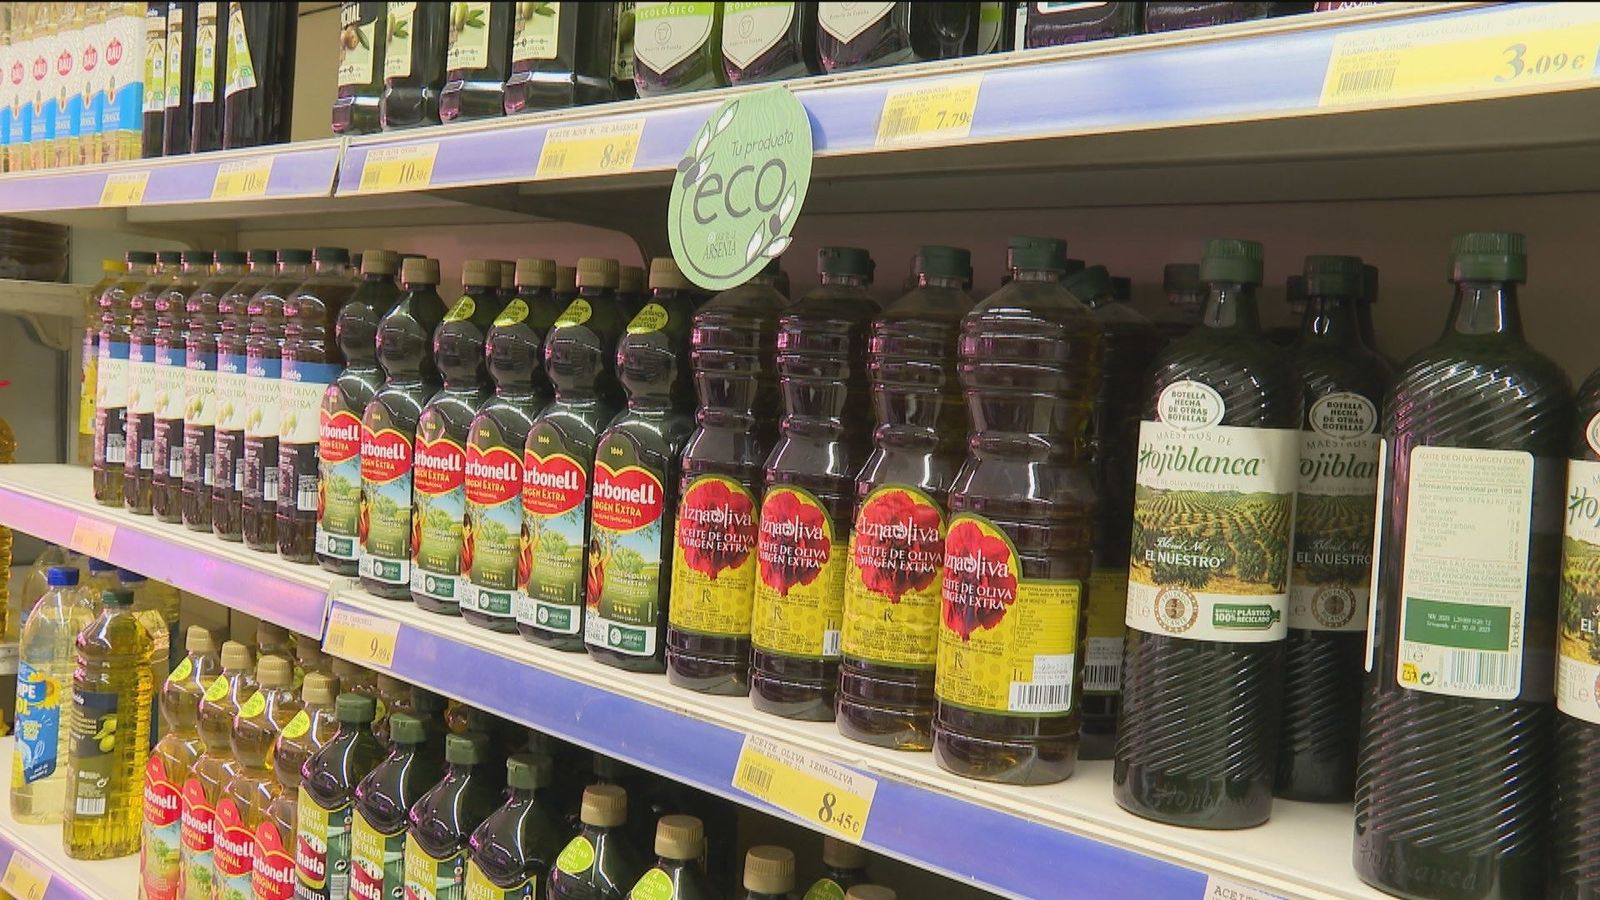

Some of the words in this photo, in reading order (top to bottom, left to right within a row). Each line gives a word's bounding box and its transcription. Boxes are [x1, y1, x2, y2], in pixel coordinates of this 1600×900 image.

[731, 141, 742, 157] Tu
[744, 129, 794, 159] producto
[693, 158, 787, 225] eco
[1171, 391, 1206, 400] BOTELLA
[1174, 399, 1201, 407] HECHA
[1168, 405, 1178, 413] DE
[1180, 407, 1208, 415] OTRAS
[1326, 402, 1363, 410] BOTELLA
[1167, 414, 1207, 423] BOTELLAS
[1323, 423, 1364, 431] BOTELLAS
[1337, 416, 1364, 424] OTRAS
[320, 422, 360, 441] arbonell
[1156, 431, 1212, 442] MAESTROS
[1217, 435, 1232, 446] DE
[361, 440, 406, 460] arbonell
[415, 451, 462, 471] arbonell
[1139, 442, 1261, 477] Hojiblanca
[1452, 454, 1473, 462] OLIVA
[1475, 455, 1503, 463] VIRGEN
[1504, 457, 1526, 465] EXTRA
[465, 457, 518, 481] arbonell
[483, 480, 506, 493] EXTRA
[523, 467, 579, 491] arbonell
[523, 486, 541, 498] IRGEN
[542, 487, 567, 502] EXTRA
[593, 478, 656, 505] arbonell
[592, 500, 614, 513] IRGEN
[615, 503, 642, 518] EXTRA
[682, 536, 714, 550] VIRGEN
[716, 542, 748, 554] EXTRA
[709, 531, 722, 542] DE
[724, 533, 755, 544] OLIVA
[780, 546, 793, 556] DE
[795, 548, 827, 560] OLIVA
[857, 545, 888, 558] ACEITE
[890, 548, 905, 560] DE
[907, 550, 943, 563] OLIVA
[1145, 550, 1156, 561] EL
[1157, 552, 1221, 569] NUESTRO
[1296, 552, 1311, 563] EL
[1313, 553, 1372, 565] NUESTRO
[788, 556, 821, 569] EXTRA
[861, 555, 896, 570] VIRGEN
[900, 560, 936, 573] EXTRA
[961, 583, 974, 595] DE
[976, 586, 1013, 600] OLIVA
[969, 596, 1005, 610] EXTRA
[1237, 607, 1271, 616] PLÁSTICO
[1215, 613, 1237, 622] 100%
[1581, 618, 1595, 633] EL
[750, 735, 777, 753] ACEITE
[780, 747, 805, 765] OLIVA
[214, 830, 255, 858] arbonell
[214, 846, 241, 868] ORIGINAL
[253, 855, 296, 884] arbonell
[252, 871, 281, 895] ORIGINAL
